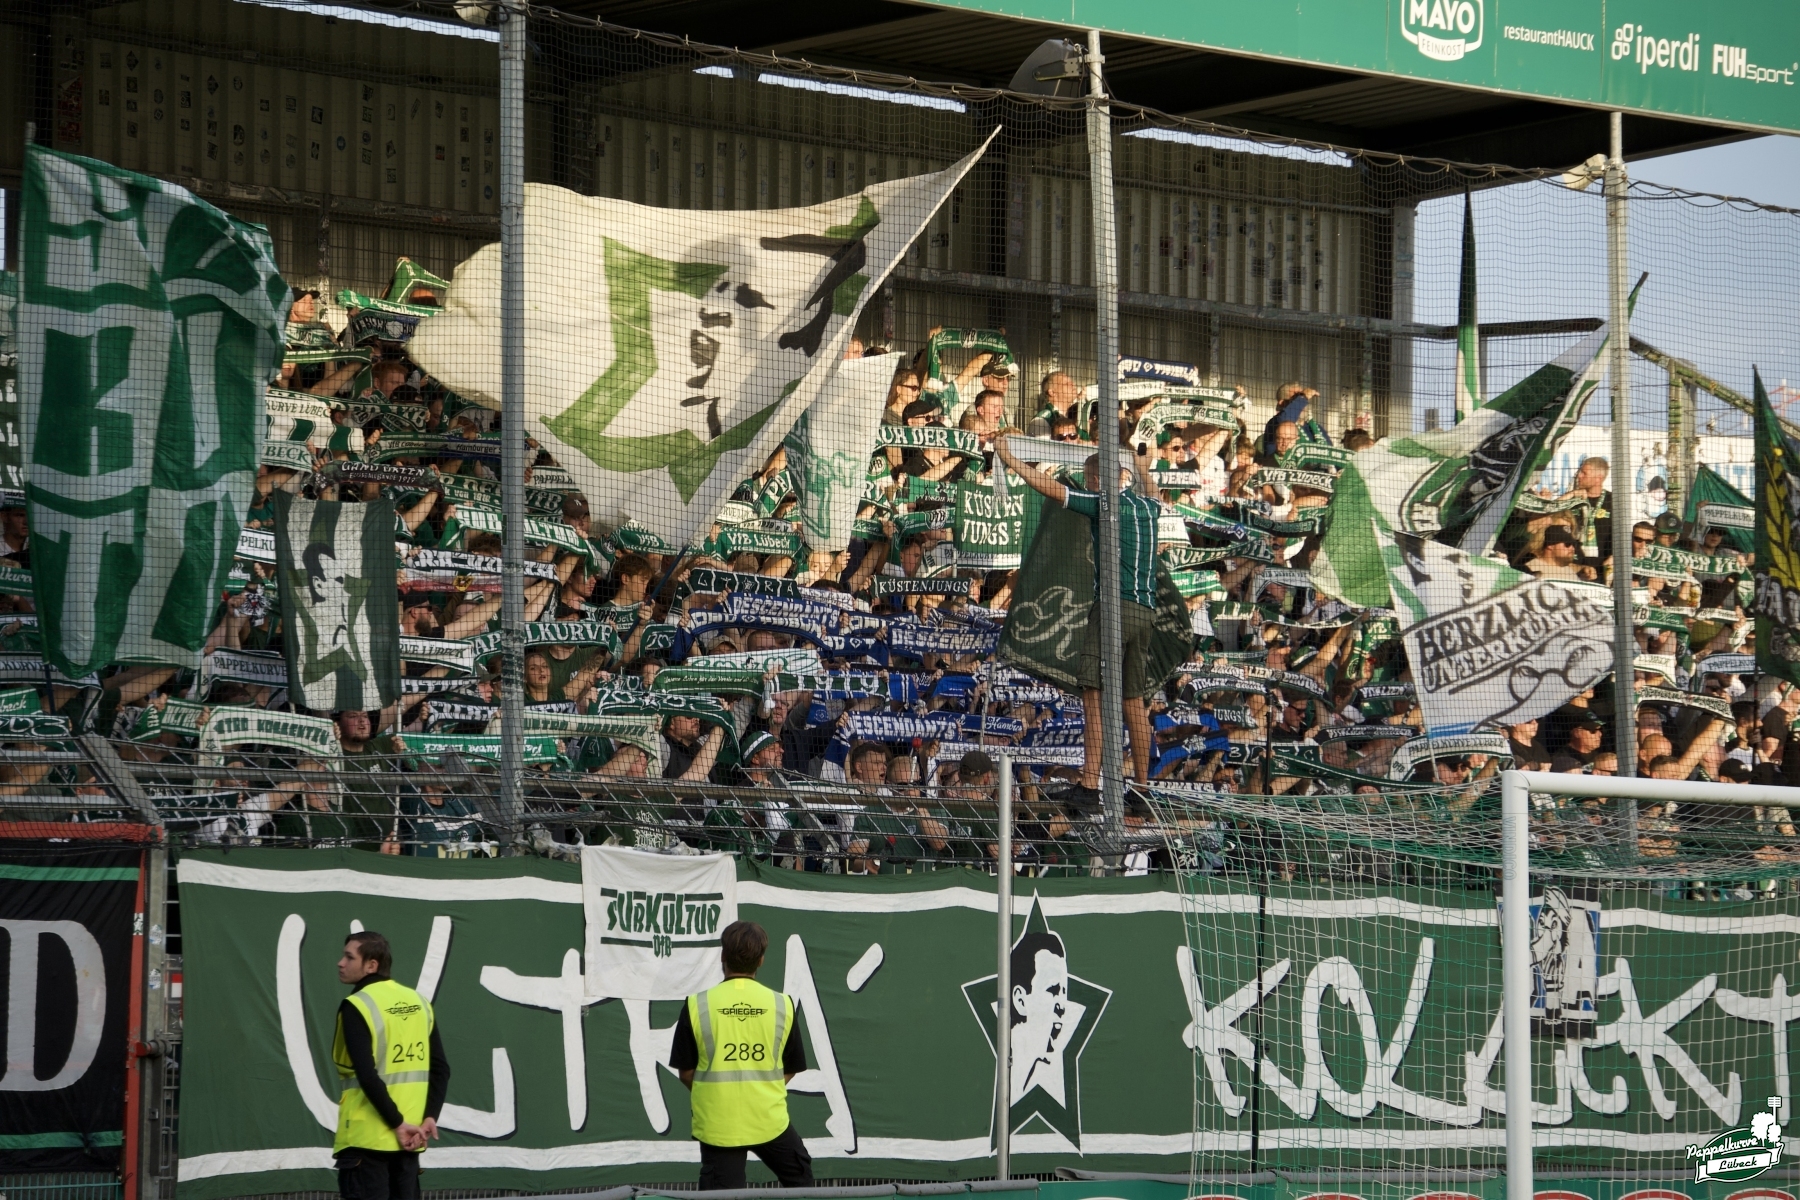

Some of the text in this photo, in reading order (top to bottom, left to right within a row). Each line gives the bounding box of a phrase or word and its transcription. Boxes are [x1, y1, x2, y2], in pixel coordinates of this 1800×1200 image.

[1409, 0, 1476, 34] MAYO
[1421, 38, 1462, 56] FEINKOST
[1504, 25, 1595, 51] restaurantHAUCK
[1635, 25, 1700, 74] iperdi
[911, 427, 949, 447] DER
[456, 443, 497, 454] Hamburger
[726, 532, 790, 549] VfB Lübeck
[961, 519, 1010, 546] JUNGS
[878, 577, 969, 594] KÜSTENJUNGS
[421, 643, 466, 658] LÜBECK
[847, 714, 957, 740] DESCENDANTS
[607, 891, 721, 935] SUBKULTUR
[653, 934, 672, 959] VfB
[388, 1004, 422, 1015] GRIEGER
[722, 1007, 763, 1016] GRIEGER
[391, 1041, 425, 1064] 243
[723, 1042, 765, 1062] 288
